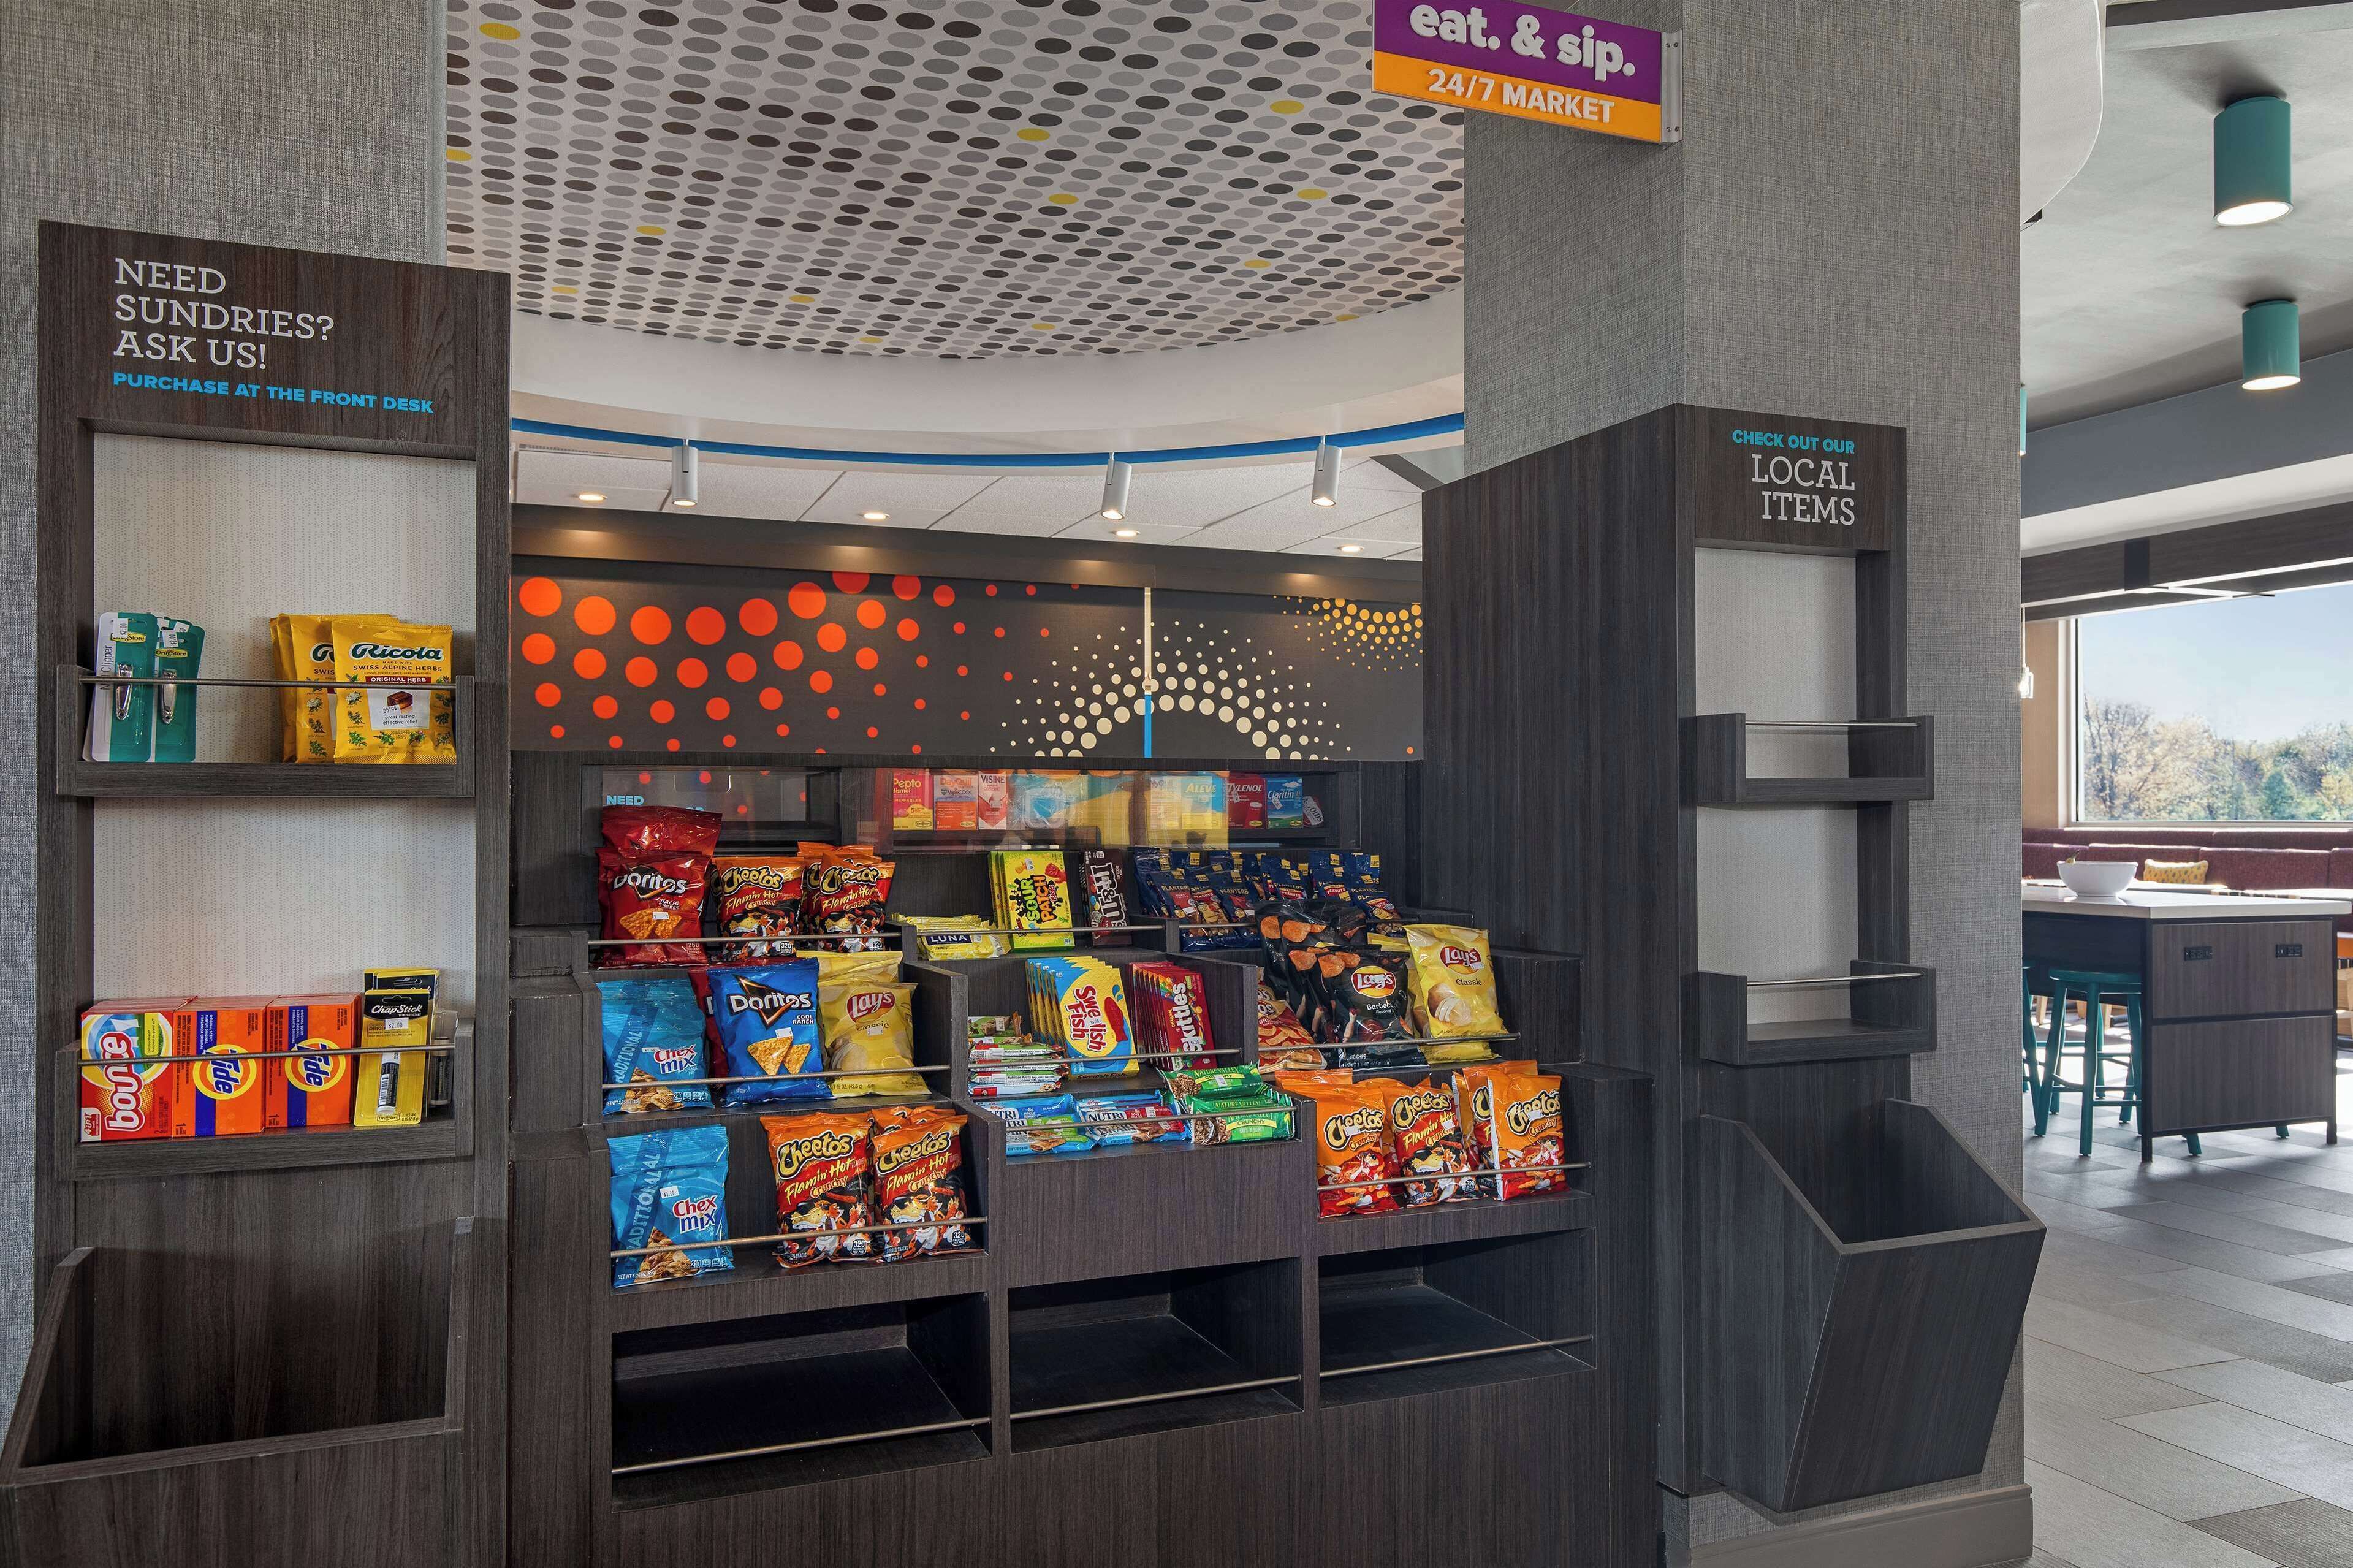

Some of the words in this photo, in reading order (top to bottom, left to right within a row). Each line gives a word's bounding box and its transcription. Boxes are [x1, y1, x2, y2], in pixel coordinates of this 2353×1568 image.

[1410, 4, 1500, 51] eat.
[1511, 14, 1546, 59] &
[1557, 25, 1635, 82] sip.
[1428, 68, 1496, 101] 24/7
[1503, 82, 1615, 123] MARKET
[115, 258, 226, 294] NEED
[115, 295, 335, 341] SUNDRIES?
[113, 330, 196, 364] ASK
[210, 340, 266, 370] US!
[113, 372, 229, 396] PURCHASE
[235, 384, 261, 398] AT
[266, 386, 305, 402] THE
[311, 390, 378, 408] FRONT
[383, 396, 434, 413] DESK
[1732, 430, 1784, 447] CHECK
[1788, 435, 1819, 451] OUT
[1823, 439, 1855, 454] OUR
[1752, 454, 1855, 490] LOCAL
[1762, 491, 1855, 525] ITEMS
[101, 645, 115, 672] Clipper
[351, 644, 443, 661] Ricola
[894, 778, 921, 789] Pepto
[981, 775, 1005, 783] VISINE
[1226, 783, 1262, 792] TYLENOL
[1268, 790, 1294, 799] Claritin
[606, 795, 644, 805] NEED
[614, 873, 688, 894] Doritos
[723, 867, 783, 894] Cheetos
[1021, 878, 1041, 922] SOUR
[1033, 875, 1055, 923] PATCH
[1445, 948, 1478, 967] Lay's
[371, 1005, 422, 1014] ChapStick
[730, 992, 811, 1012] Doritos
[852, 991, 892, 1019] Lay's
[1172, 983, 1203, 1052] Skittles
[1068, 1003, 1089, 1039] Fish
[295, 1043, 330, 1087] Tide
[613, 1029, 643, 1084] RADITIONAL
[655, 1045, 696, 1062] Chex
[203, 1049, 241, 1095] Tide
[1195, 1069, 1217, 1079] NATURE
[1089, 1113, 1124, 1122] NUTRI
[1325, 1108, 1383, 1147] Cheetos
[1393, 1094, 1450, 1128] Cheetos
[1507, 1092, 1561, 1133] Cheetos
[1529, 1117, 1557, 1136] Crunchy
[779, 1132, 852, 1177] Cheetos
[878, 1133, 949, 1171] Cheetos
[1350, 1134, 1378, 1151] Crunchy
[785, 1167, 827, 1205] Flamin'
[830, 1157, 854, 1175] Hot
[810, 1175, 848, 1198] Crunchy
[886, 1164, 927, 1198] Flamin'
[929, 1152, 951, 1171] Hot
[908, 1168, 948, 1192] Crunchy
[626, 1170, 662, 1261] RADITIONAL
[674, 1195, 717, 1216] Chex
